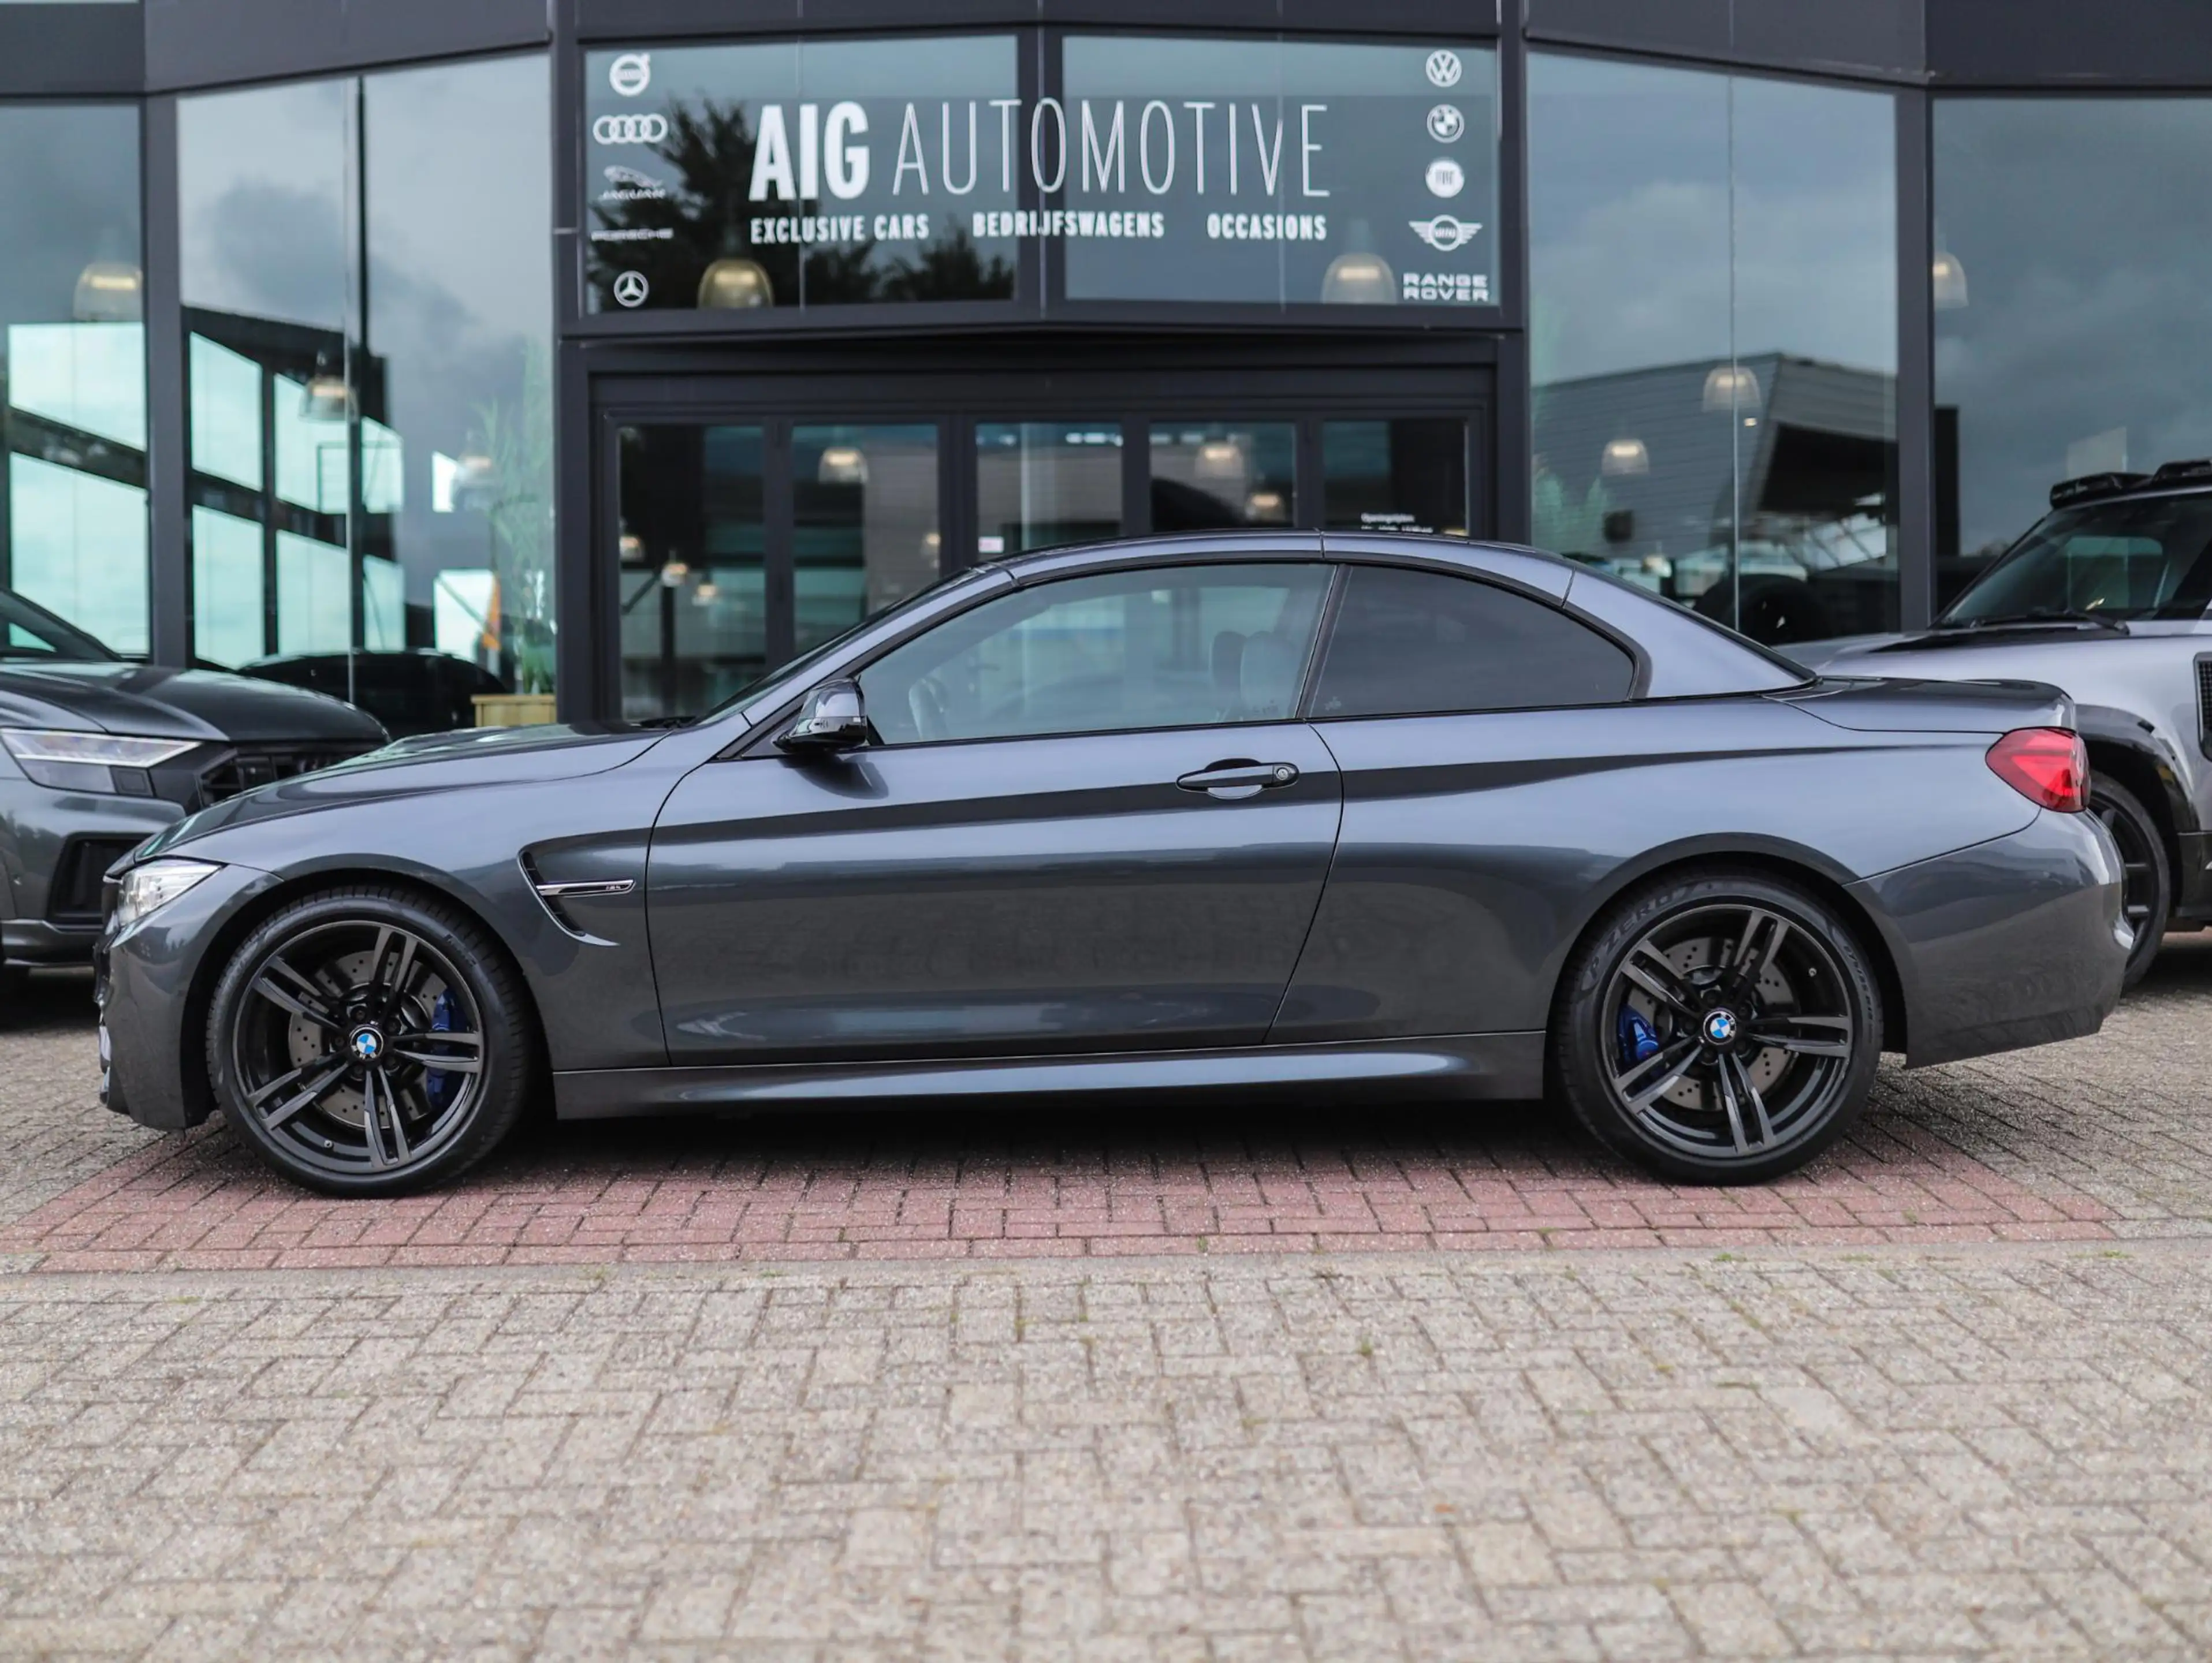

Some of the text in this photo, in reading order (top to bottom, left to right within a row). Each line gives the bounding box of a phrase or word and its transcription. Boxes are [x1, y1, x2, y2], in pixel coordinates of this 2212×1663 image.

[748, 97, 1330, 201] AIG AUTOMOTIVE
[750, 210, 1327, 244] EXCLUSIVE CARS BEDRIJFSWAGENS OCCASIONS
[1403, 273, 1488, 288] RANGE
[1403, 288, 1489, 301] ROVER
